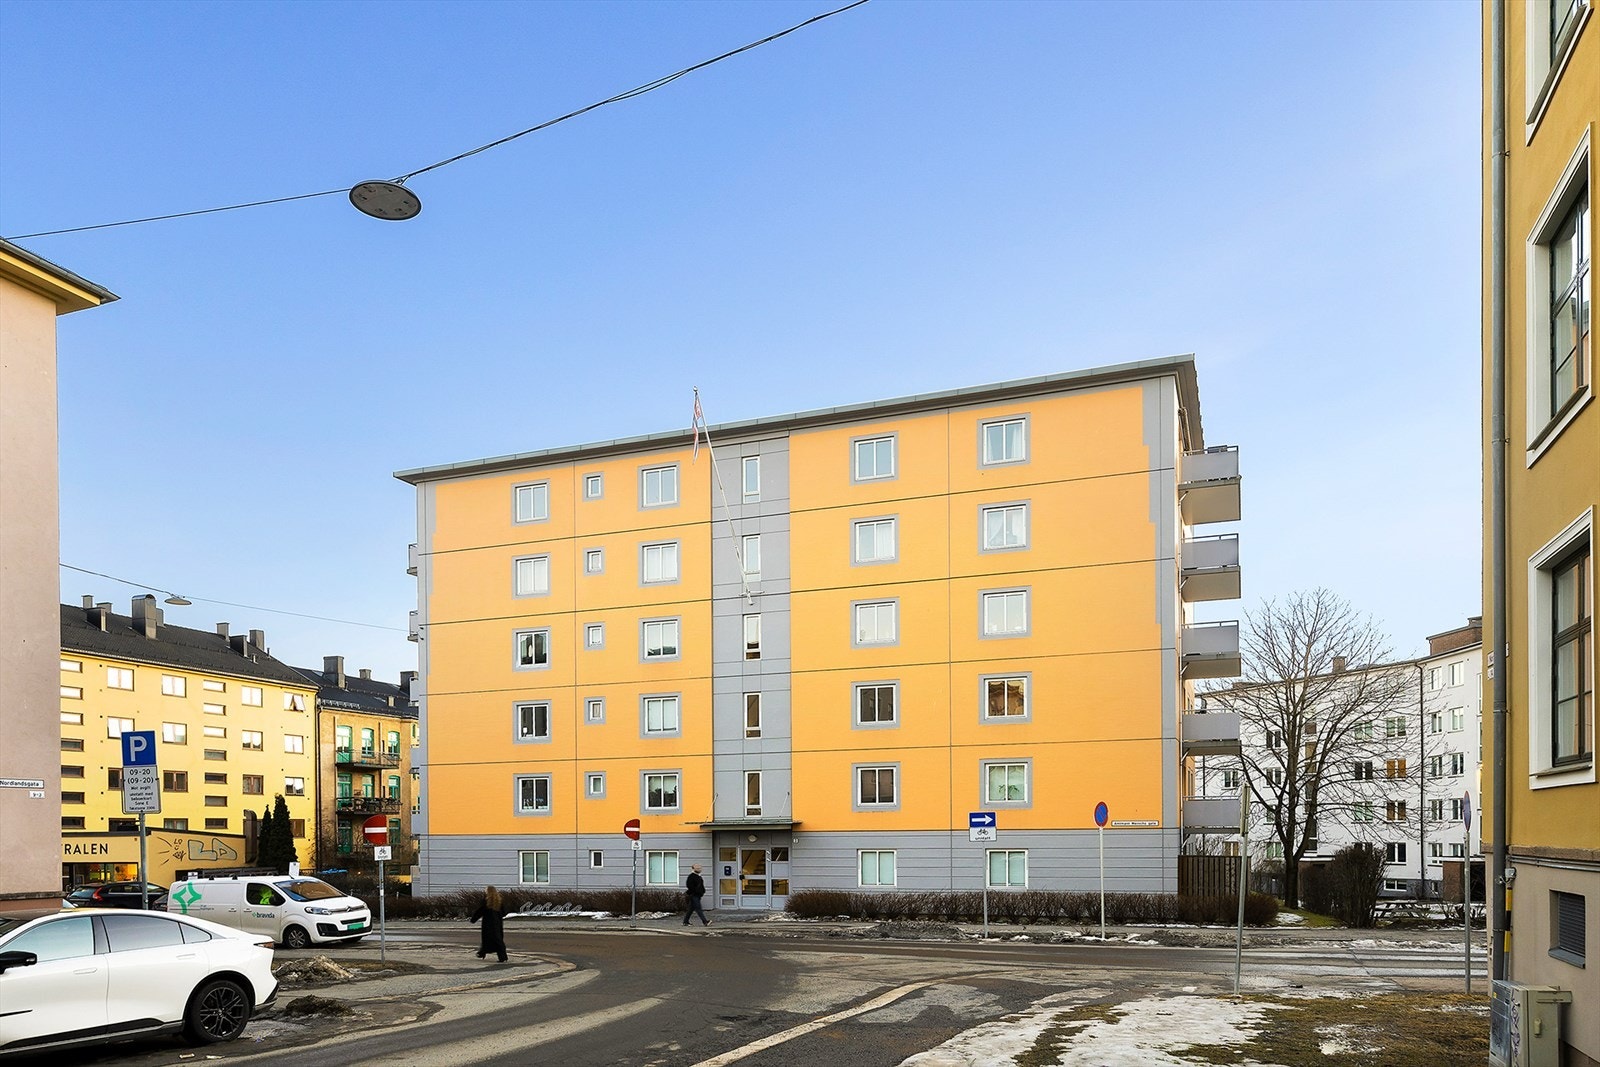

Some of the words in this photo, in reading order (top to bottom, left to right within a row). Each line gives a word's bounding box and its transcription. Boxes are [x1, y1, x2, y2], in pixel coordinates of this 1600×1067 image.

[129, 735, 147, 762] P
[127, 777, 154, 785] (09-20)
[61, 843, 108, 855] RALEN
